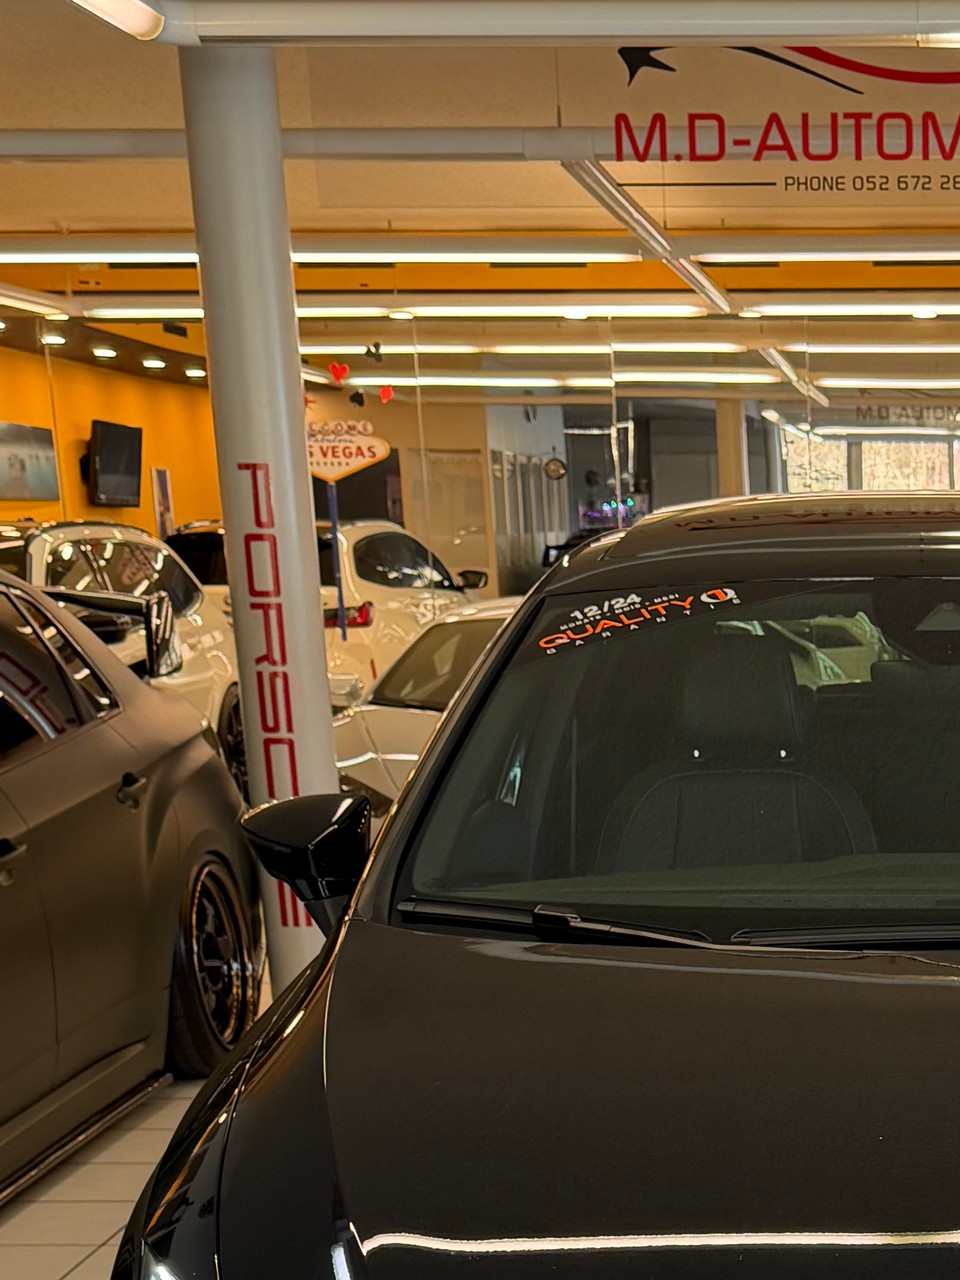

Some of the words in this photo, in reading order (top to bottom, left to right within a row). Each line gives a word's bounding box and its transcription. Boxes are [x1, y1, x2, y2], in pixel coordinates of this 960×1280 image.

[783, 175, 846, 192] PHONE
[852, 174, 889, 191] 052
[896, 174, 932, 191] 672
[319, 445, 377, 459] VEGAS
[570, 593, 642, 620] 12/24
[538, 595, 695, 648] QUALITY
[237, 462, 313, 928] PORSCE
